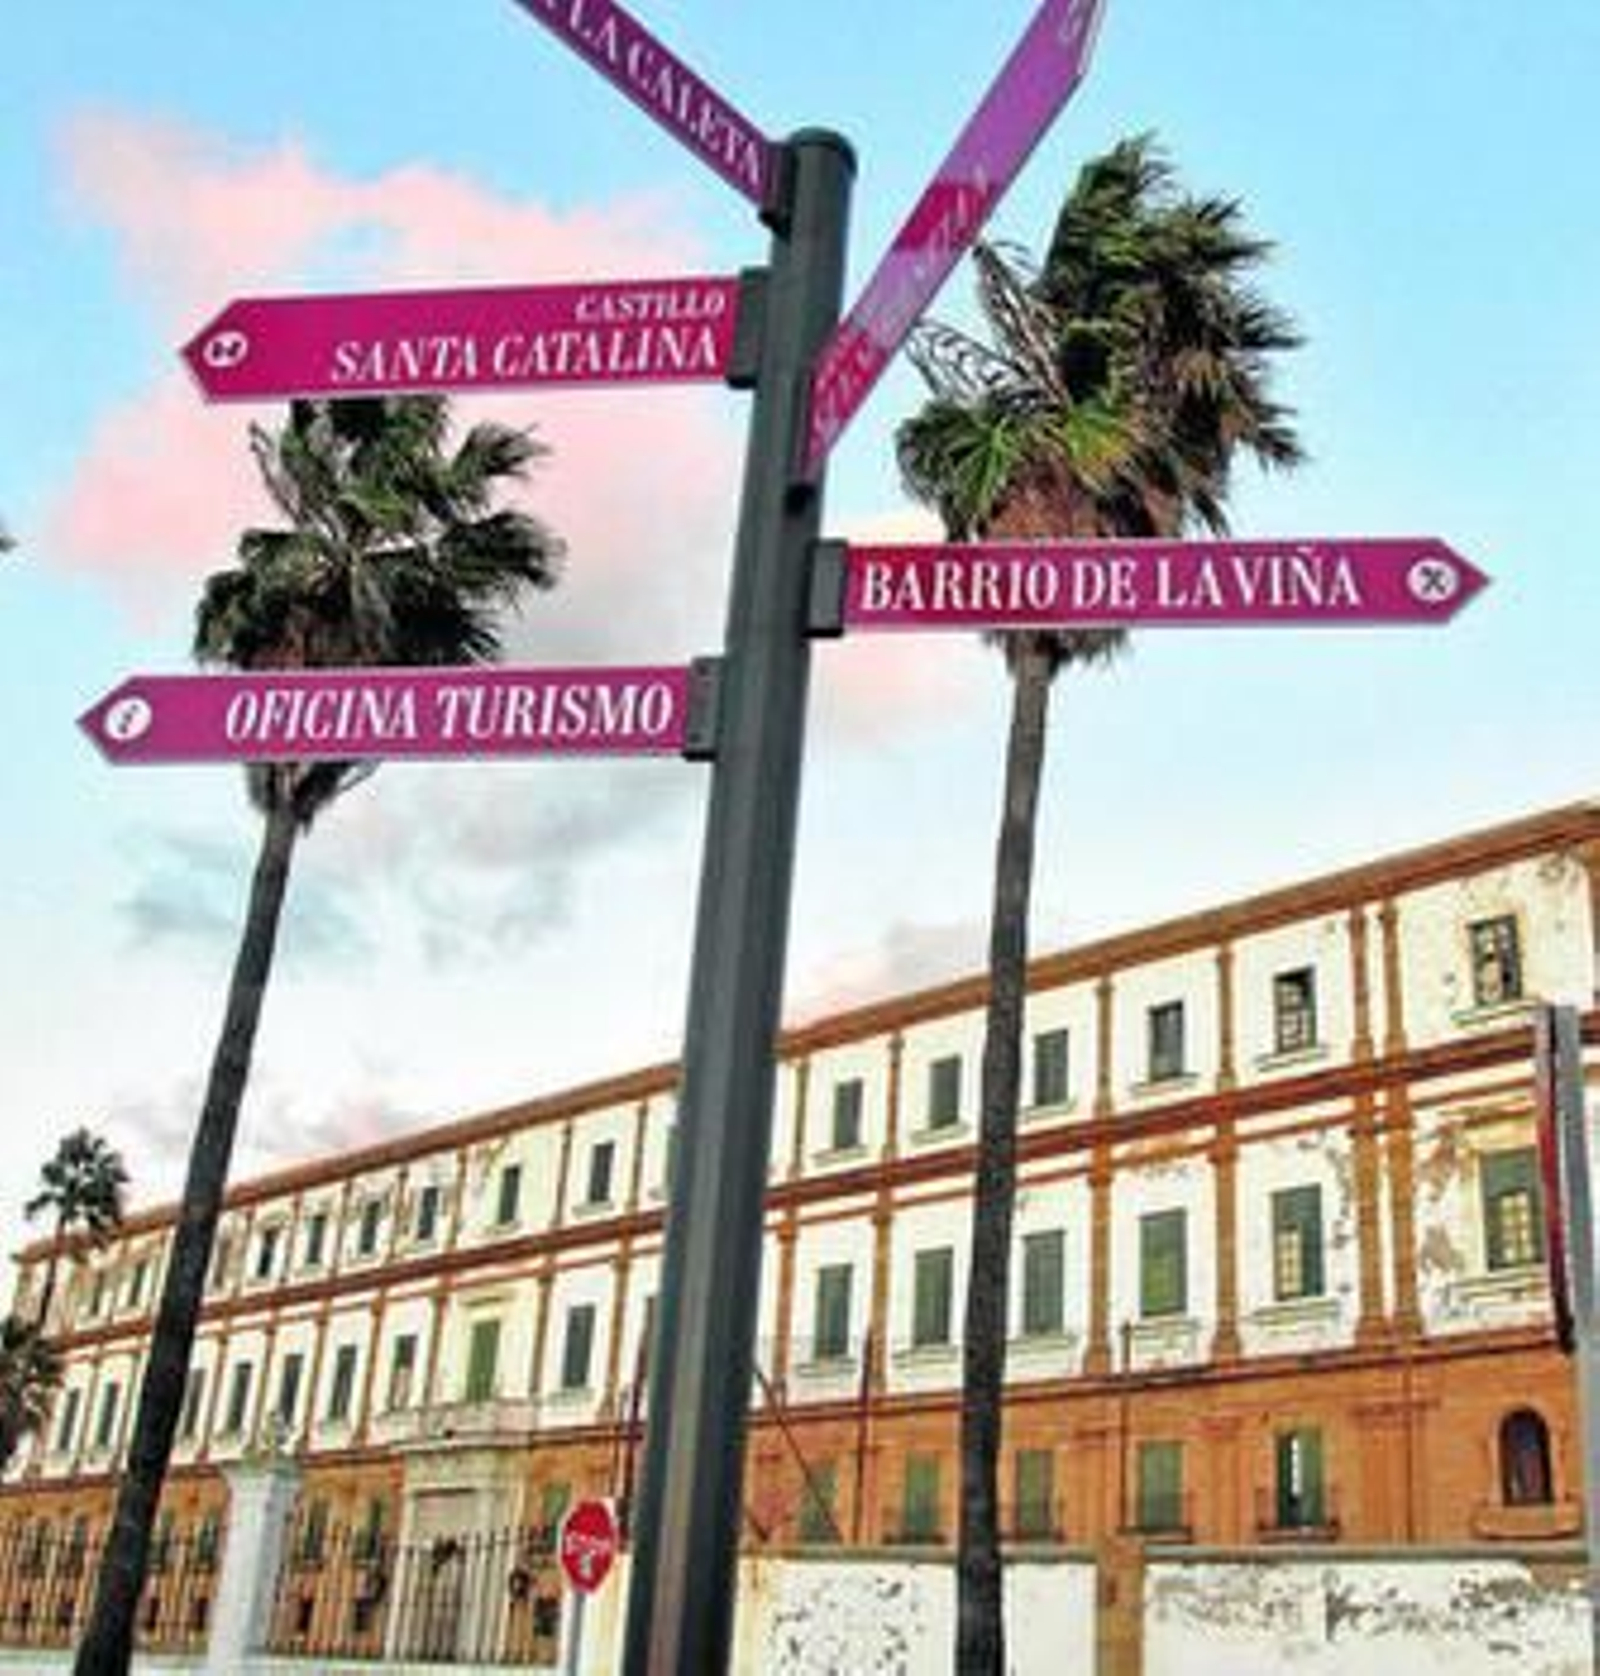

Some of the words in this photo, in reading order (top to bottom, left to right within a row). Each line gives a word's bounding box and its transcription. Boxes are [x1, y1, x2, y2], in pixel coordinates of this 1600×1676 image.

[568, 0, 616, 63] LA
[627, 40, 759, 189] CALETA
[575, 289, 726, 323] CASTILLO
[331, 335, 477, 382] SANTA
[493, 327, 717, 378] CATALINA
[861, 560, 1059, 610] BARRIO
[1071, 559, 1137, 608] DE
[1157, 558, 1222, 607] LA
[1224, 547, 1361, 607] VIÑA
[224, 686, 419, 743] OFICINA
[434, 682, 674, 740] TURISMO
